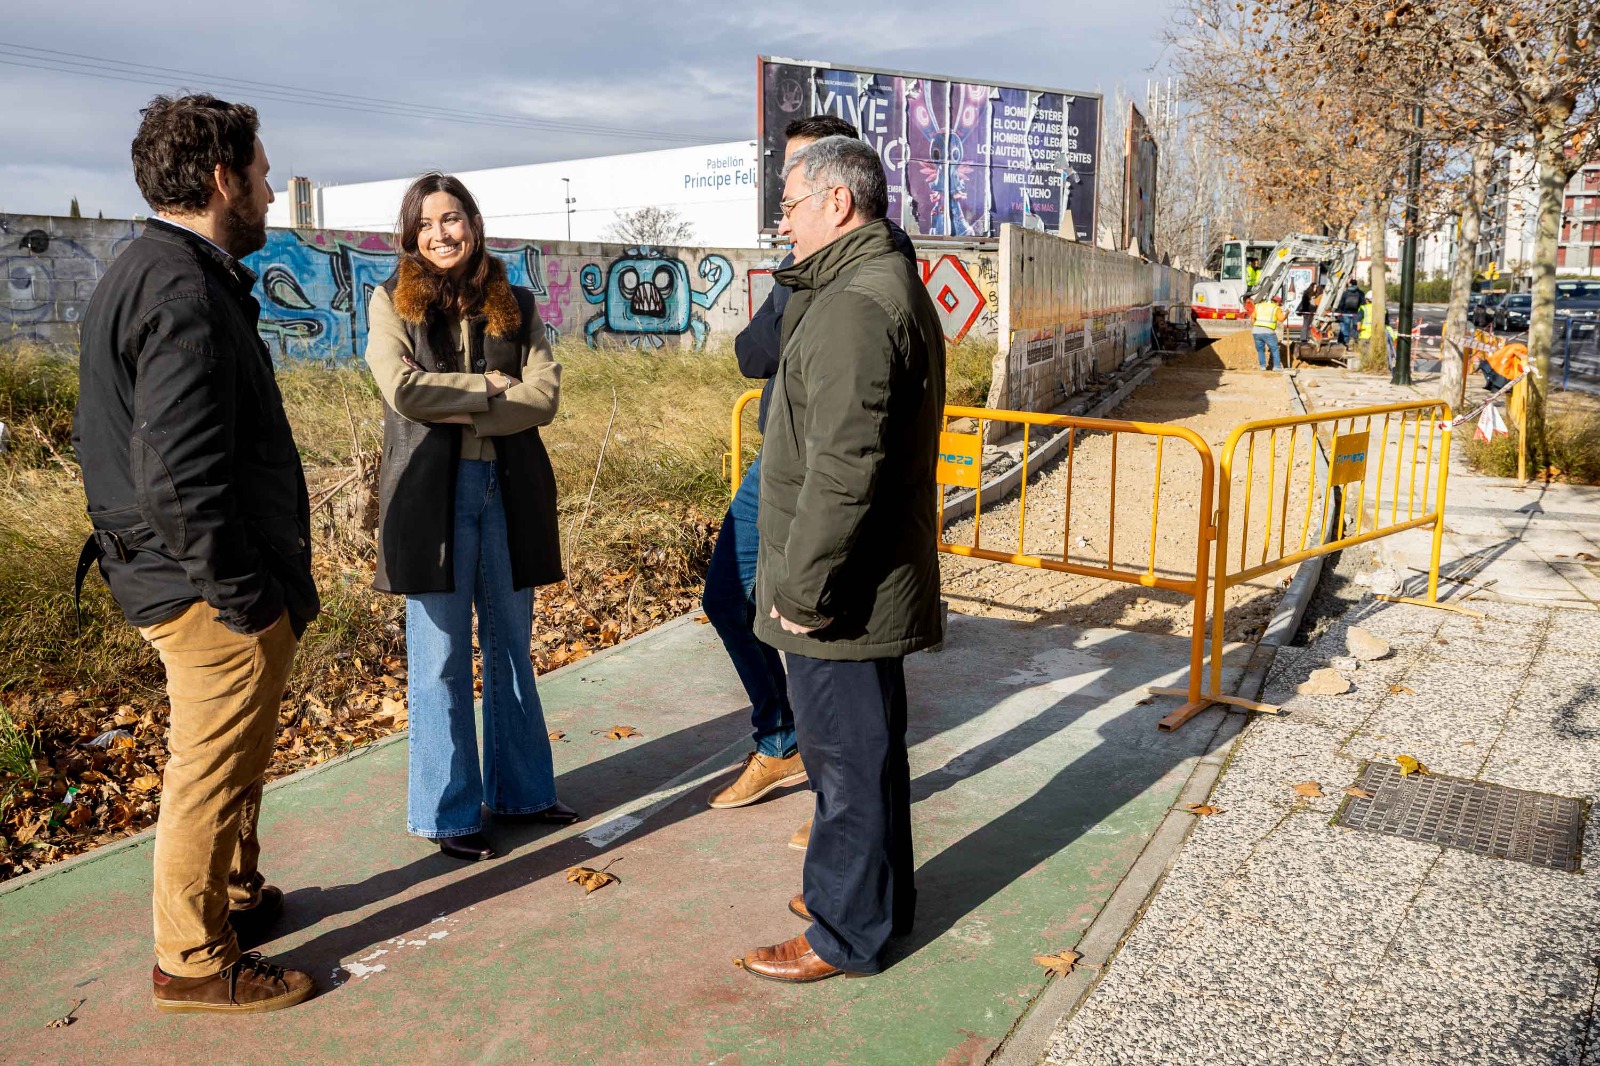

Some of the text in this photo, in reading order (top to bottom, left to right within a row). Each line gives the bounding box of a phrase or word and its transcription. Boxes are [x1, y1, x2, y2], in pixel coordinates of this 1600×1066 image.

[1004, 105, 1063, 122] BOMB ESTÉRE
[993, 118, 1079, 136] EL COLUPIO ASESNO
[1033, 135, 1040, 146] G
[736, 168, 756, 185] Feli
[1003, 172, 1062, 187] MIKEL IZAL SFD
